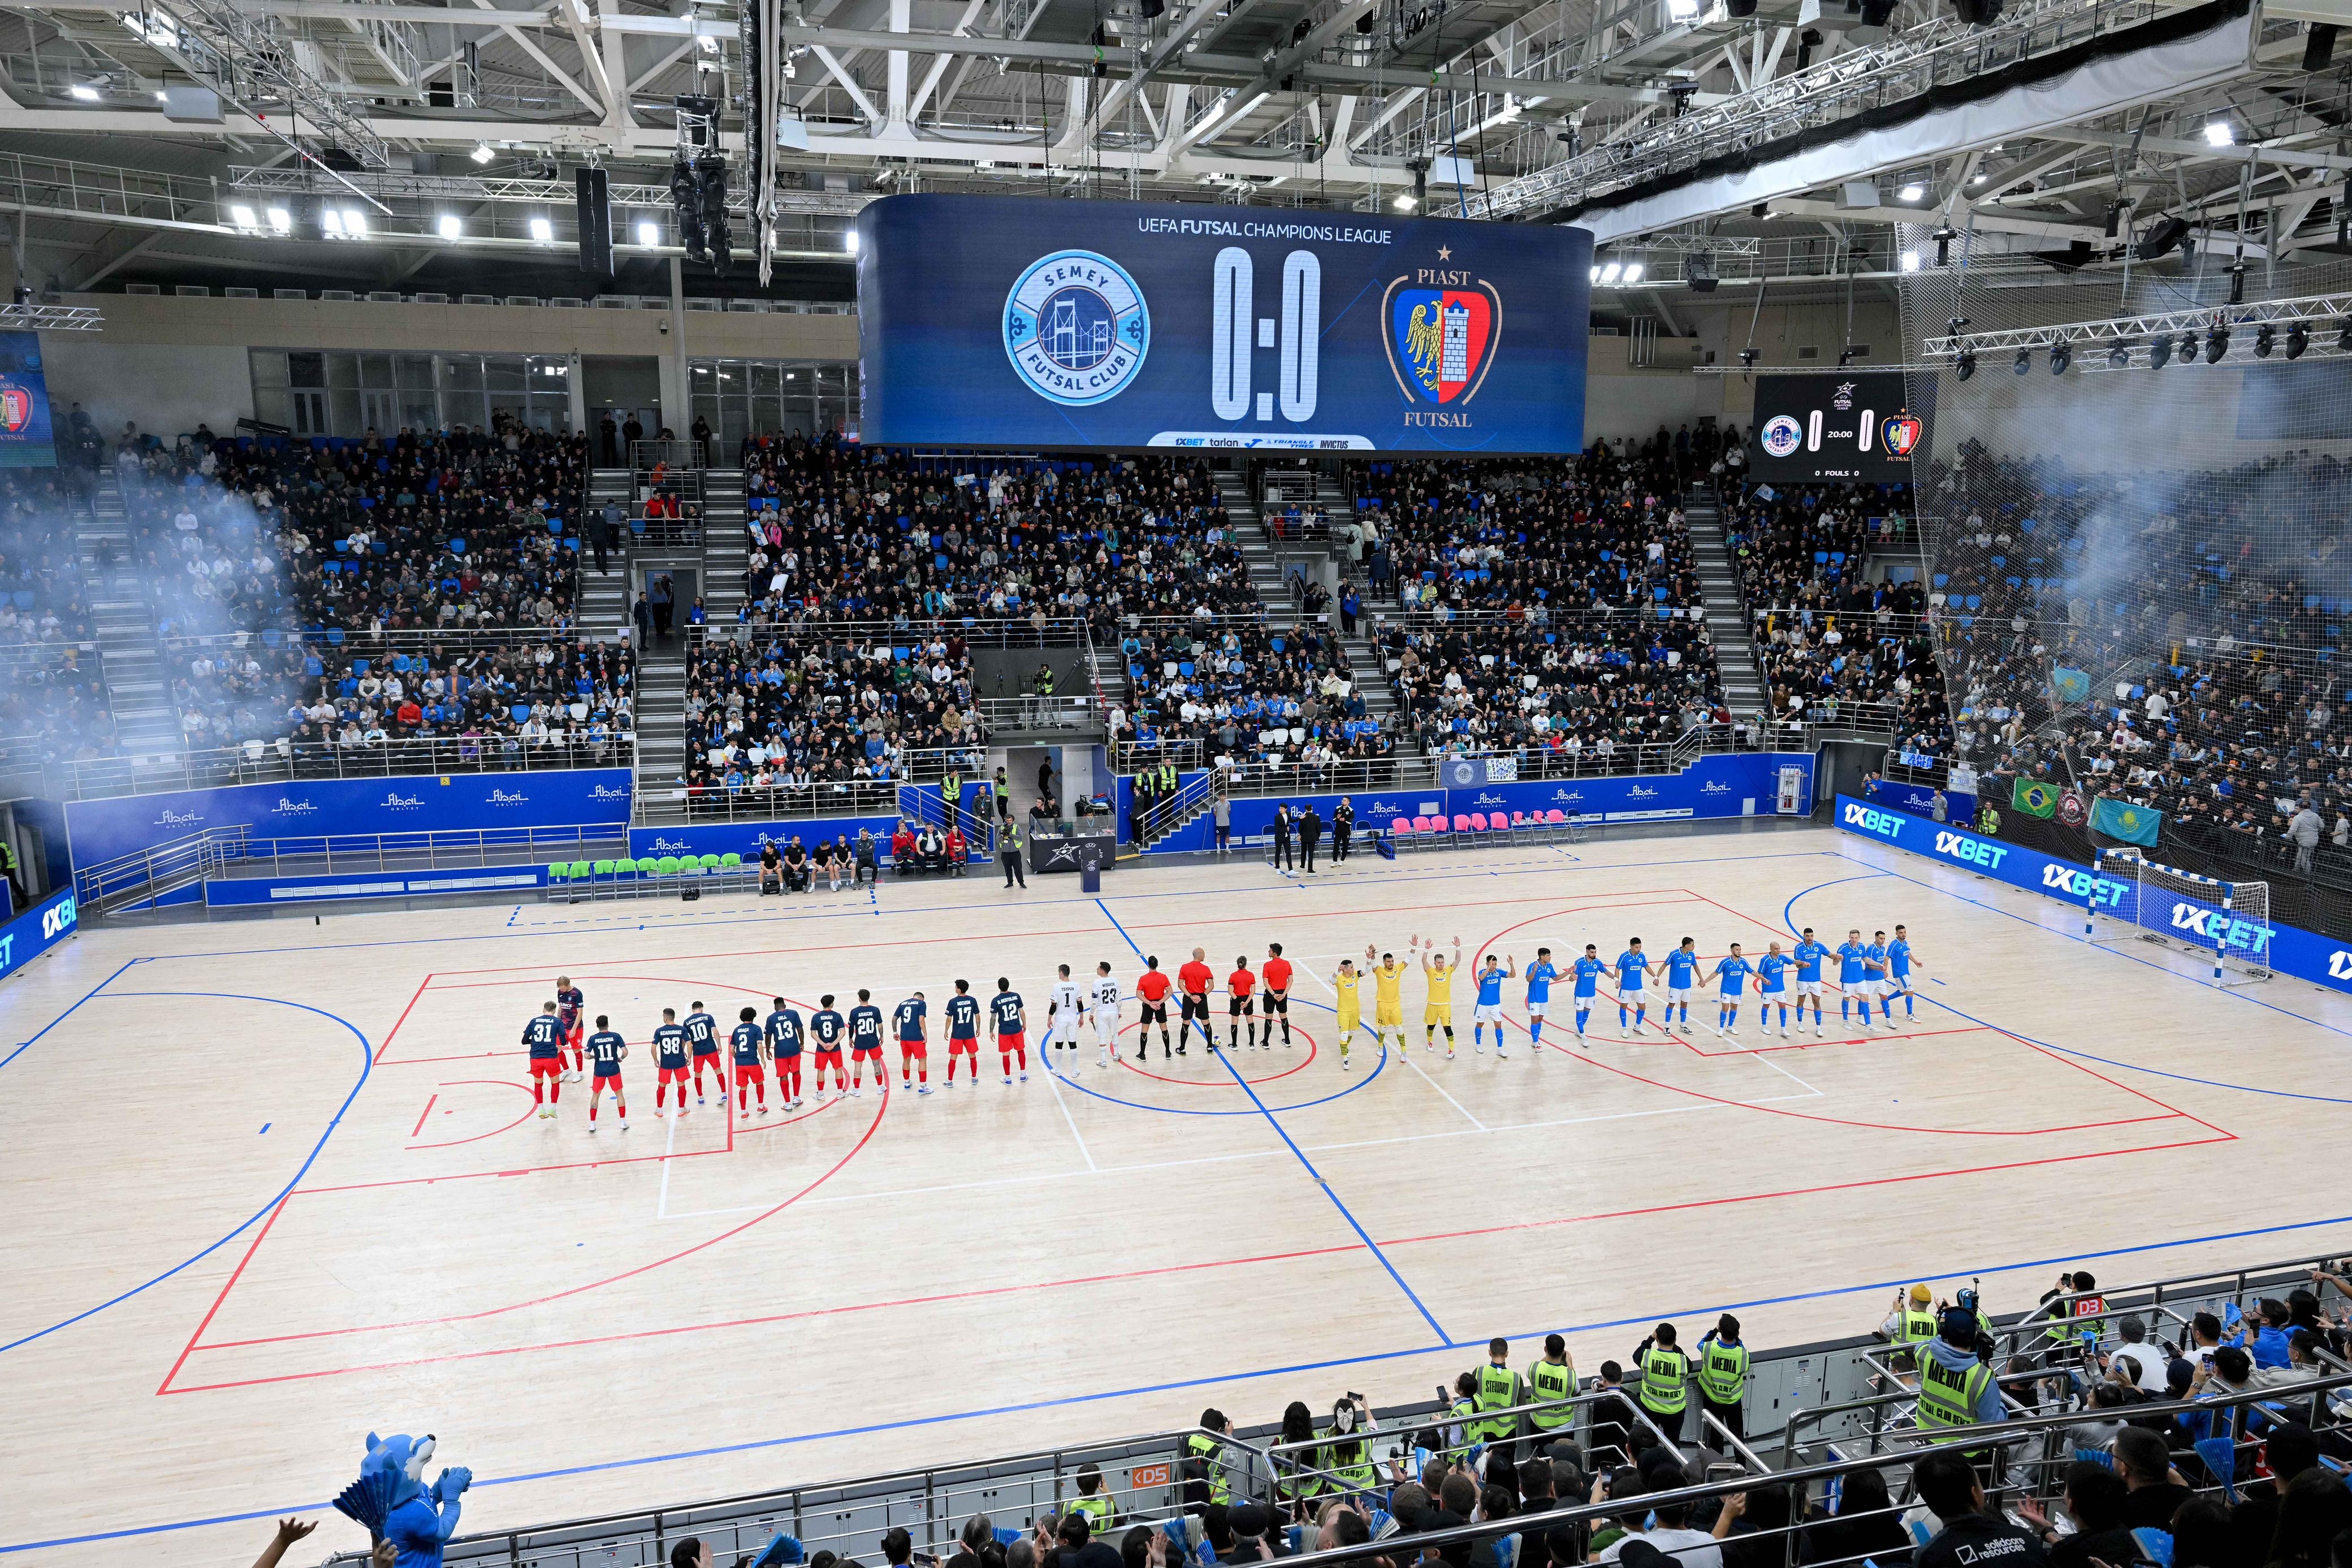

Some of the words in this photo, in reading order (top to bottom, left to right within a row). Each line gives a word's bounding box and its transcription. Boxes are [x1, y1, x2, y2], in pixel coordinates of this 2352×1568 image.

[1138, 218, 1179, 233] UEFA
[1181, 219, 1242, 236] FUTSAL
[1244, 222, 1333, 241] CHAMPIONS
[1335, 227, 1392, 244] LEAGUE
[1044, 266, 1109, 288] SEMEY
[1417, 268, 1471, 286] PIAST
[1027, 353, 1084, 390] FUTSAL
[1089, 355, 1126, 387] CLUB
[1403, 412, 1472, 428] FUTSAL
[1808, 410, 1823, 452] 0
[1858, 409, 1874, 452] 0
[1209, 438, 1239, 447] tarlan
[1320, 440, 1348, 449] INVICTUS
[1767, 443, 1783, 453] FUTSAL
[1783, 442, 1795, 452] CLUB
[1844, 803, 1906, 838] 1XBET
[1935, 830, 2008, 869] 1XBET
[2042, 863, 2129, 908] 1XBET
[42, 896, 76, 940] 1XB
[2172, 902, 2276, 954] 1XBET
[1064, 993, 1070, 1008] 1
[1101, 989, 1117, 1004] 23
[685, 1016, 708, 1026] LAZZARETTI
[903, 1006, 912, 1023] 9
[957, 1006, 972, 1024] 17
[1001, 1003, 1018, 1021] 12
[534, 1024, 552, 1042] 31
[690, 1022, 708, 1042] 10
[775, 1021, 794, 1041] 13
[822, 1021, 833, 1038] 8
[858, 1017, 875, 1035] 20
[662, 1037, 680, 1055] 98
[739, 1034, 749, 1052] 2
[597, 1044, 614, 1062] 11
[2079, 1299, 2099, 1315] D3
[1910, 1320, 1934, 1336] MEDIA
[1651, 1359, 1676, 1378] MEDIA
[1711, 1355, 1737, 1375] MEDIA
[1538, 1374, 1563, 1393] MEDIA
[1927, 1358, 1968, 1394] MEDIA
[1485, 1380, 1510, 1396] STEWARD
[1645, 1385, 1658, 1396] FUTSAL
[1919, 1397, 1935, 1416] FUTSAL
[1936, 1407, 1951, 1422] CLUB
[1145, 1467, 1168, 1485] D5
[1978, 1544, 2026, 1560] resources
[1984, 1537, 2025, 1550] solidcore
